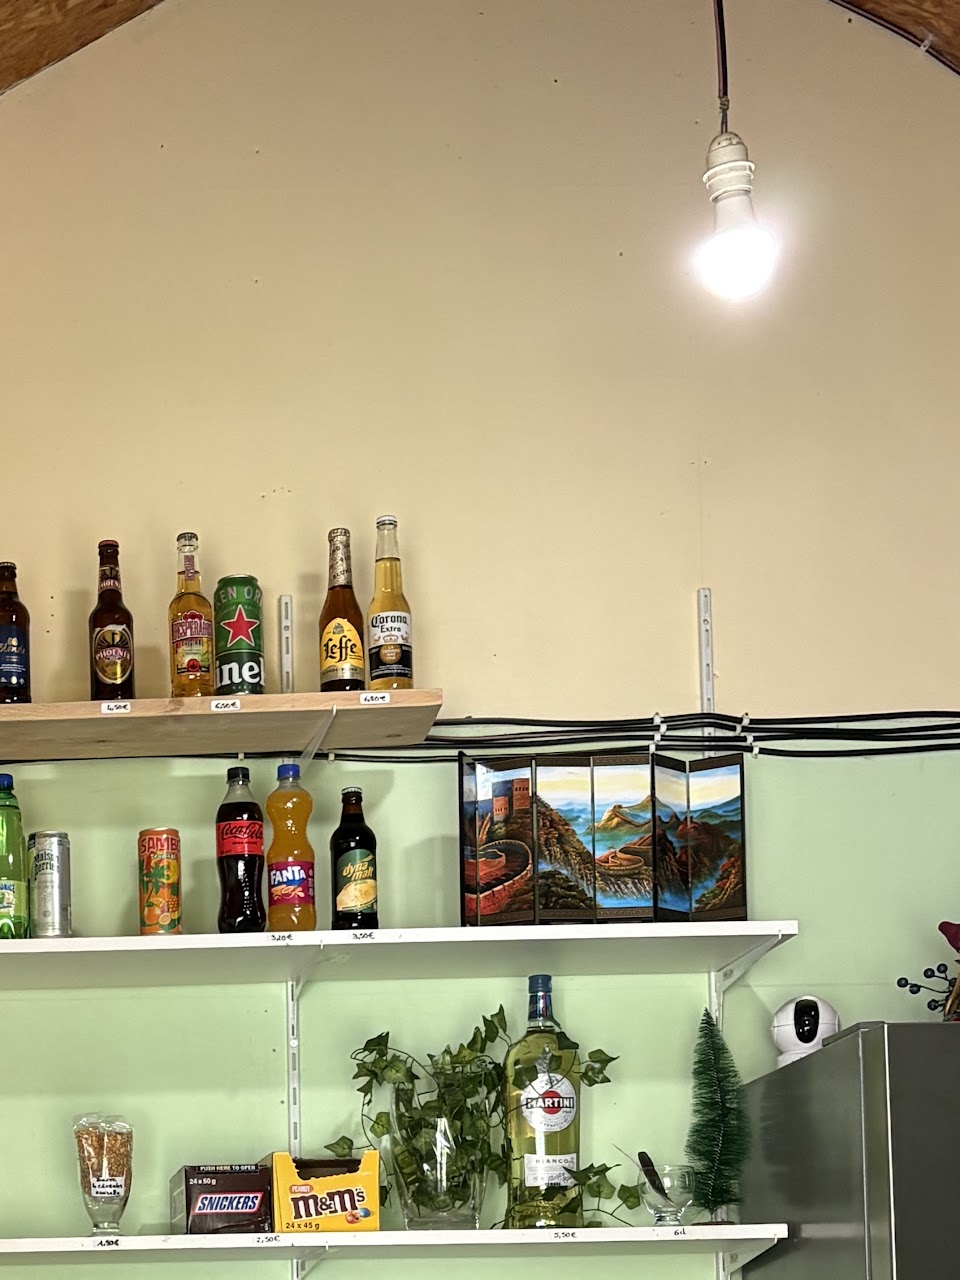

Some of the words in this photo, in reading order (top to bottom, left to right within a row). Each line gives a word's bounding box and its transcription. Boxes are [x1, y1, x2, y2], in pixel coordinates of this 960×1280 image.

[371, 613, 408, 629] Corona
[380, 625, 402, 633] Extra
[323, 635, 357, 664] Leffe
[270, 865, 307, 885] FANTA
[343, 860, 370, 878] dyna
[526, 1096, 575, 1109] MARTINI
[197, 1194, 259, 1212] SNICKERS
[285, 1222, 295, 1230] 24
[303, 1222, 313, 1230] 45
